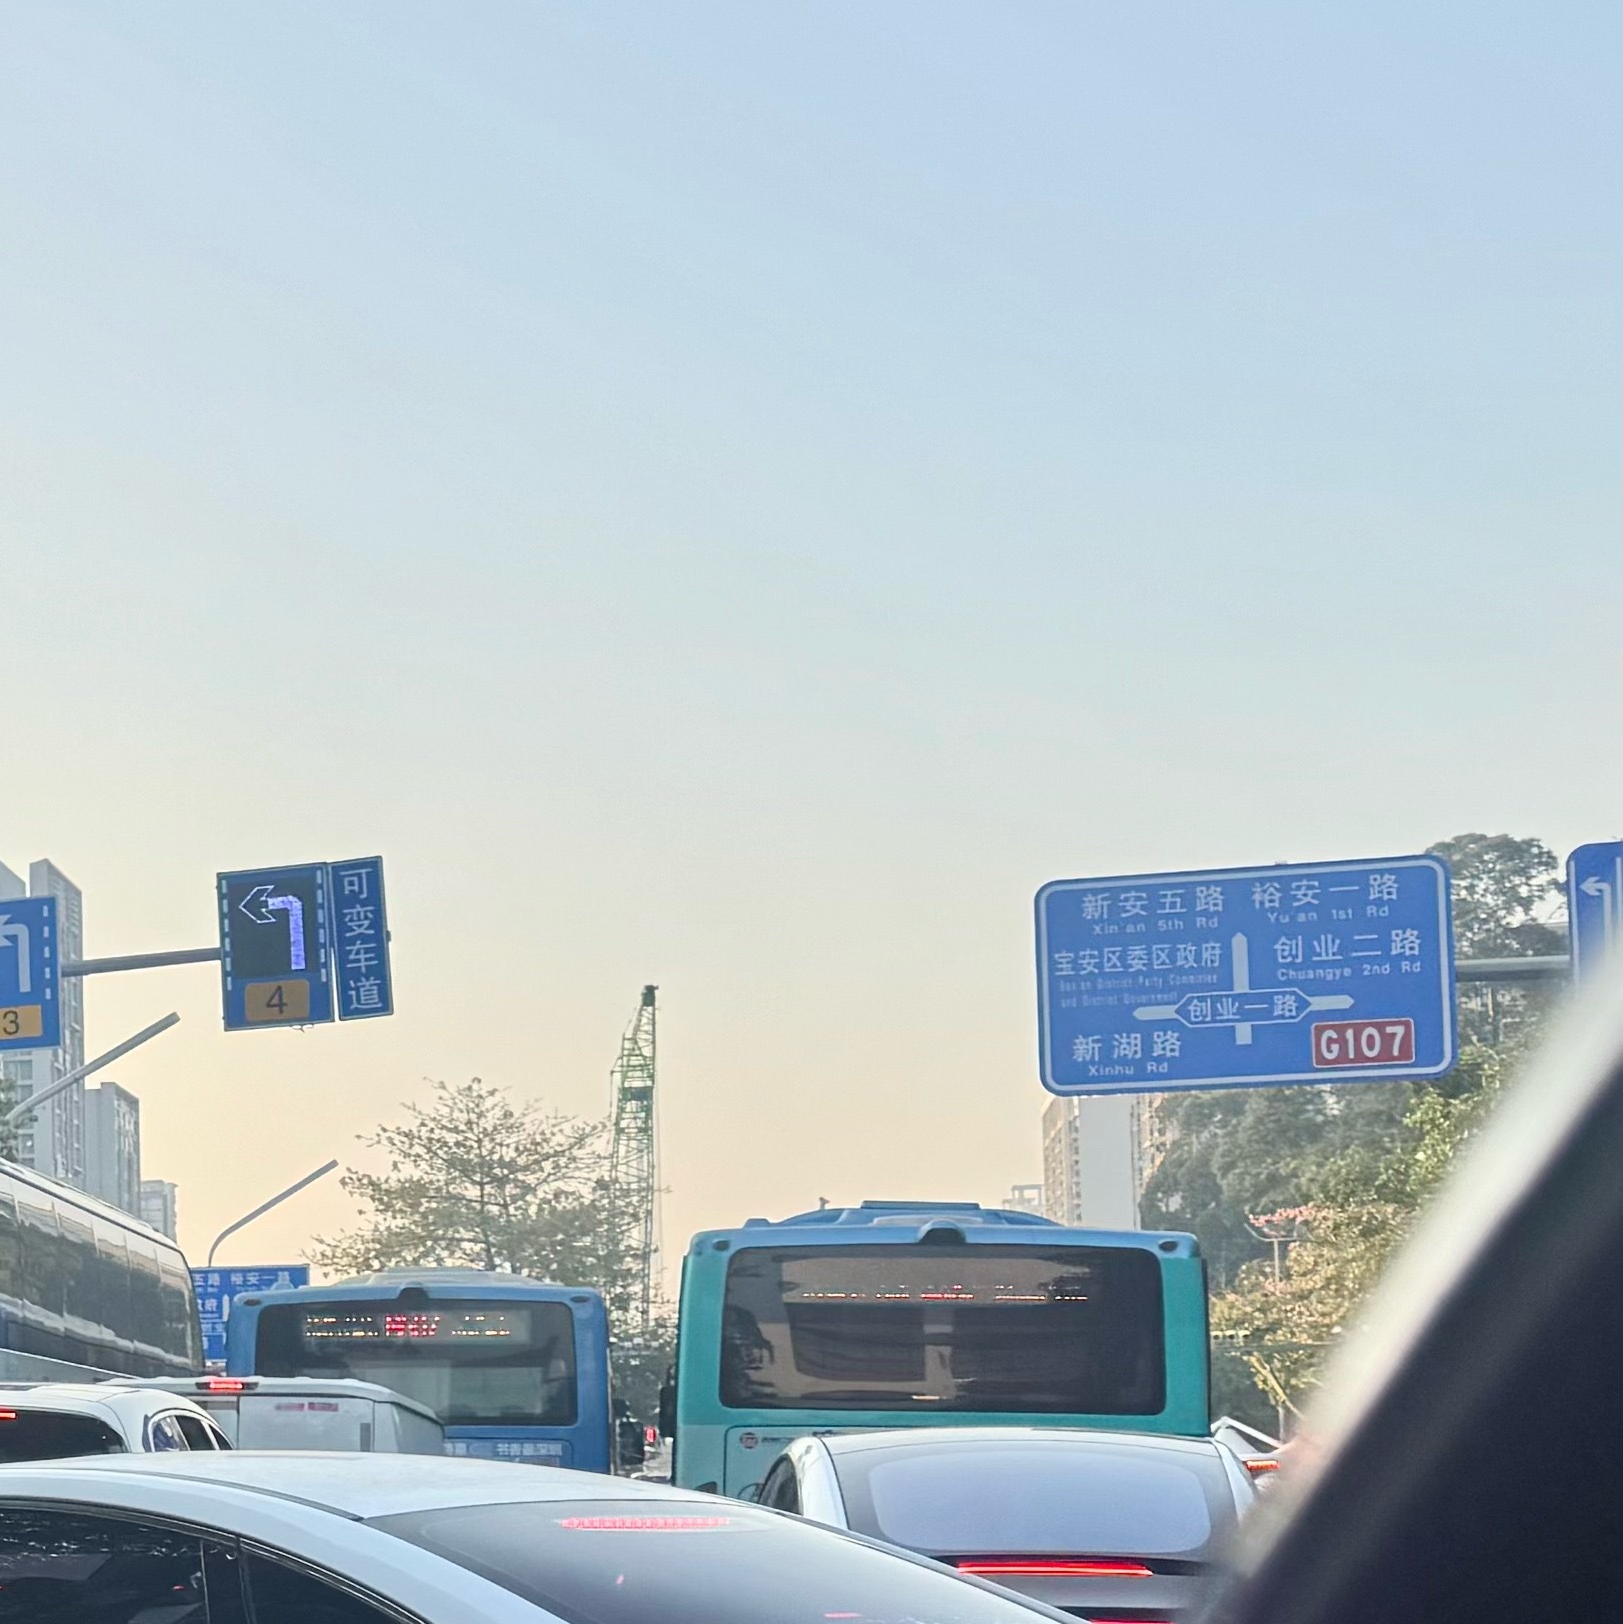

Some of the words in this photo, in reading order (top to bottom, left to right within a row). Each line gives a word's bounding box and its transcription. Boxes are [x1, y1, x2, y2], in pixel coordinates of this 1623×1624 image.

[1081, 885, 1225, 920] 新安五路
[1250, 873, 1401, 910] 裕安一路
[1157, 916, 1185, 931] 5th
[1196, 915, 1219, 929] Rd
[1331, 907, 1353, 920] 1st
[1366, 904, 1390, 918] Rd
[338, 866, 383, 1013] 可变车道
[1273, 928, 1422, 964] 创业二路
[1054, 941, 1224, 976] 宝安区委区政府
[1277, 966, 1352, 982] Chuangye
[1362, 962, 1391, 976] 2nd
[1401, 960, 1421, 974] Rd
[264, 986, 289, 1014] 4
[1187, 991, 1299, 1022] 创业一路
[2, 1011, 20, 1036] 3
[1072, 1030, 1183, 1064] 新湖路
[1320, 1026, 1406, 1061] G107
[1088, 1063, 1134, 1077] Xinhu
[1147, 1061, 1169, 1074] Rd
